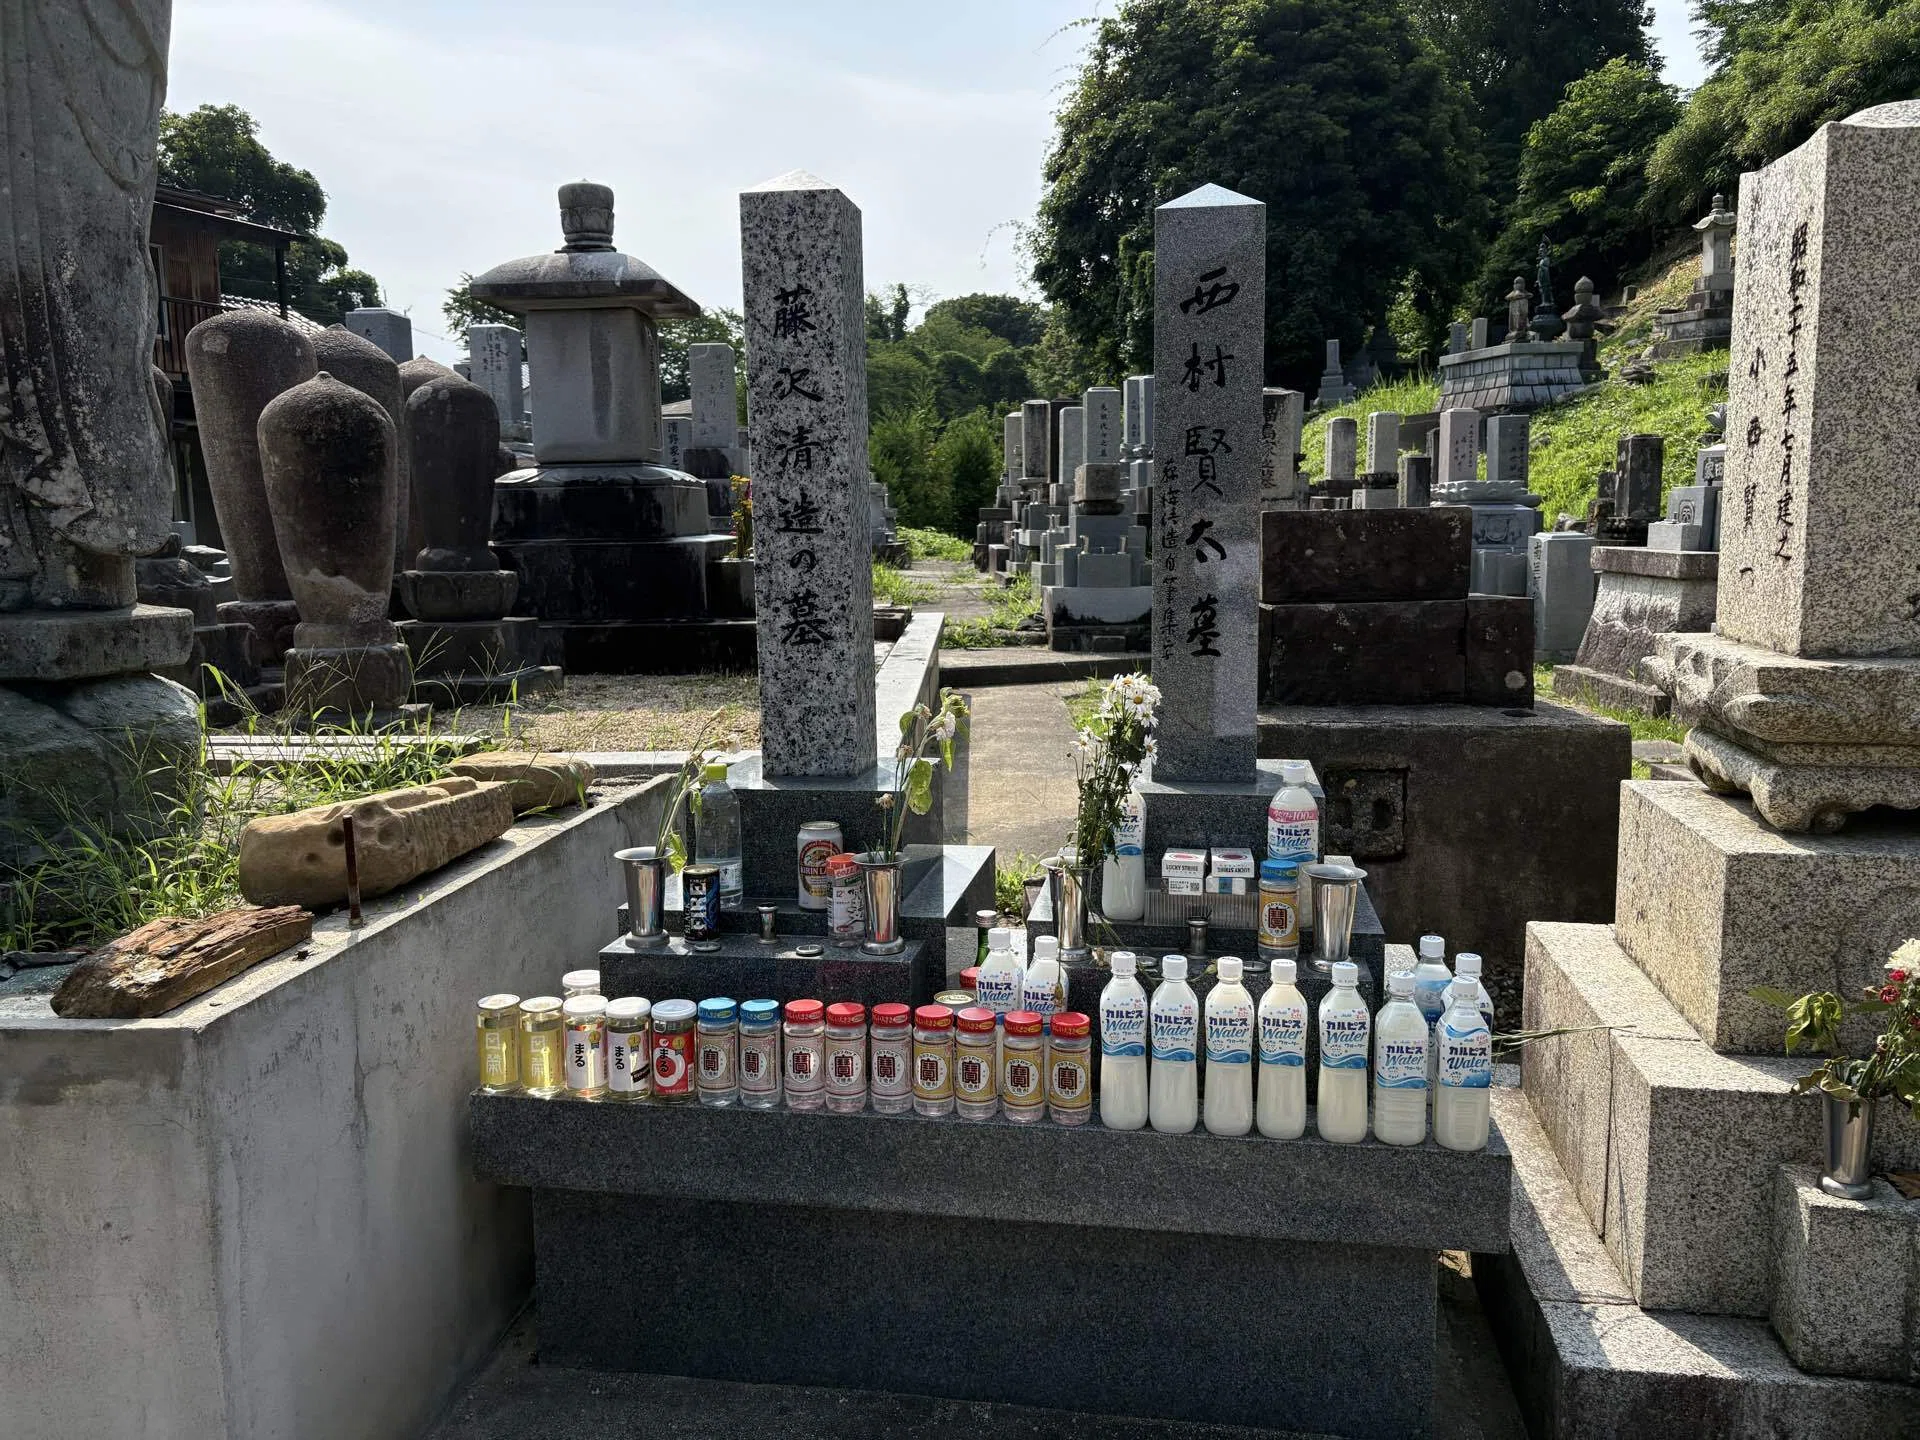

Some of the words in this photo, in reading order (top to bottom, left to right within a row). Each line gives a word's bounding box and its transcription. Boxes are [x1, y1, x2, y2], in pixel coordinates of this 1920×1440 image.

[769, 283, 834, 646] 藤沢清造の墓
[1277, 828, 1311, 837] カルピス
[1276, 835, 1312, 847] Water
[977, 981, 1012, 990] カルピス
[977, 990, 1013, 1001] Water
[1105, 1009, 1144, 1019] カルピス
[1154, 1013, 1193, 1025] カルピス
[1105, 1018, 1144, 1031] Water
[1209, 1016, 1248, 1027] カルピス
[1262, 1016, 1301, 1028] カルピス
[1326, 1021, 1368, 1030] カルピス
[1154, 1022, 1193, 1036] Water
[1209, 1026, 1249, 1039] Water
[1262, 1026, 1302, 1040] Water
[1326, 1030, 1367, 1044] Water
[574, 1043, 586, 1068] まる
[1386, 1045, 1423, 1055] カルピス
[1449, 1046, 1487, 1056] カルピス
[614, 1046, 625, 1070] まる
[659, 1048, 669, 1072] まる
[1385, 1054, 1424, 1066] Water
[1447, 1057, 1489, 1070] Water
